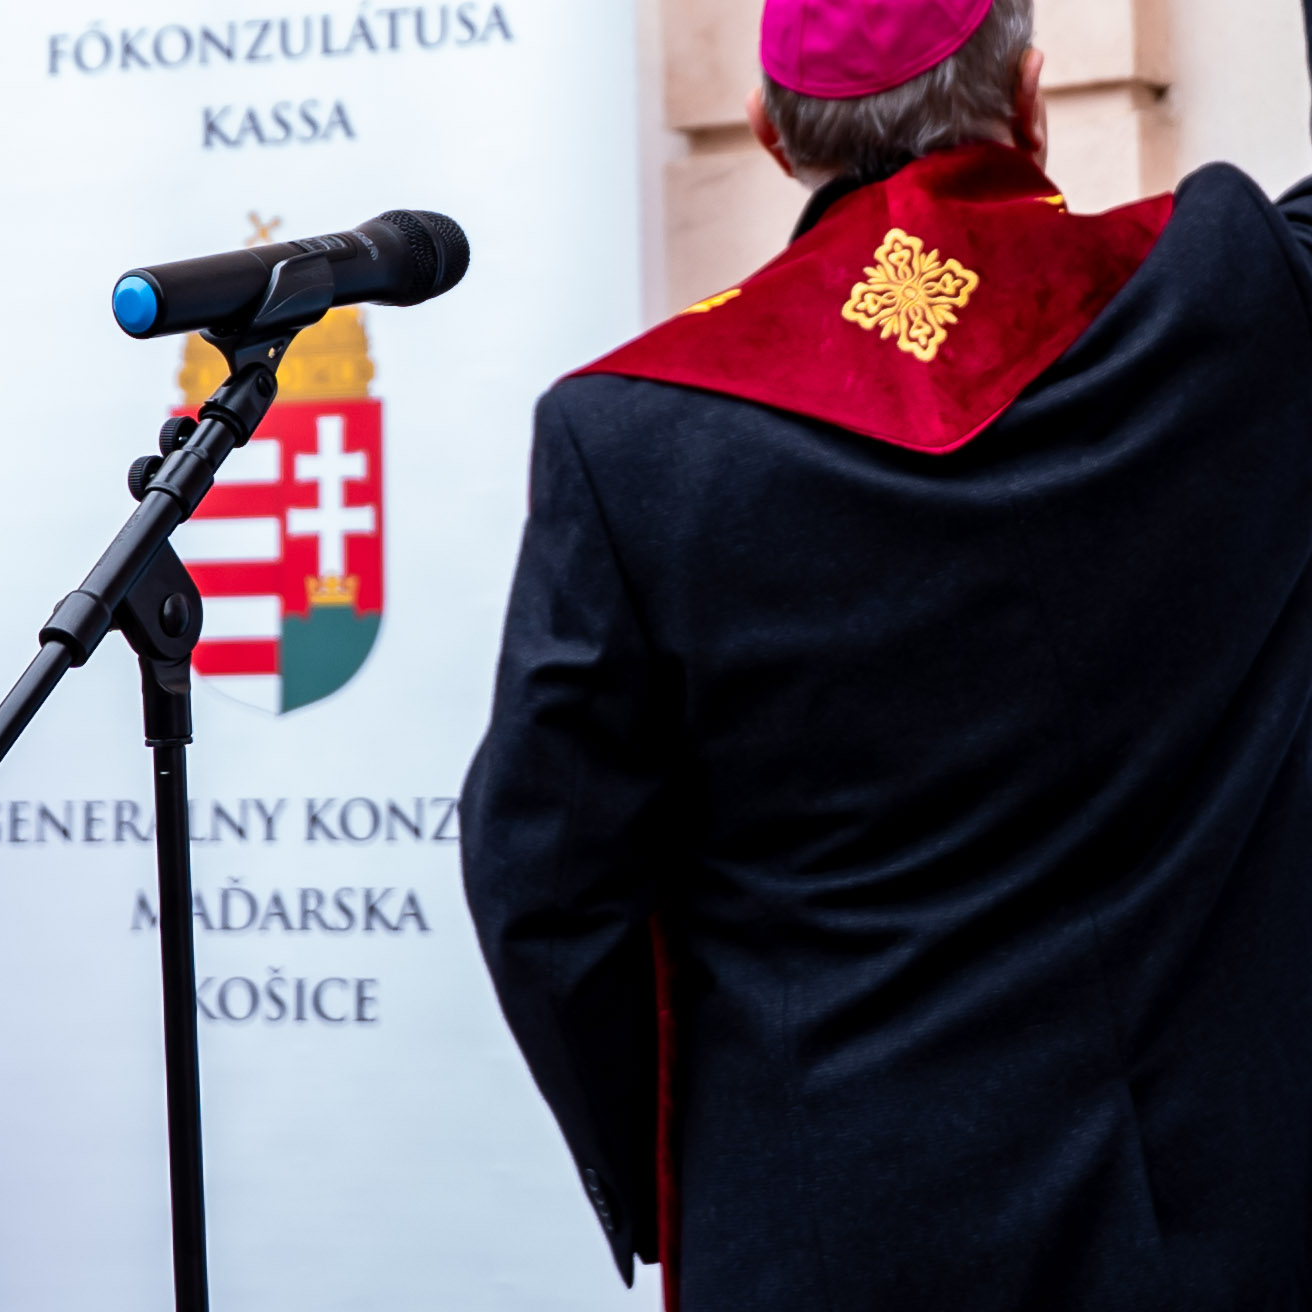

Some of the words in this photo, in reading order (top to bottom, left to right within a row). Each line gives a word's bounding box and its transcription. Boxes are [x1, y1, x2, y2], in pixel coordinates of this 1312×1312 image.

[47, 1, 515, 76] FŐKONZULÁTUSA
[201, 100, 356, 149] KASSA
[305, 797, 459, 844] KONZ
